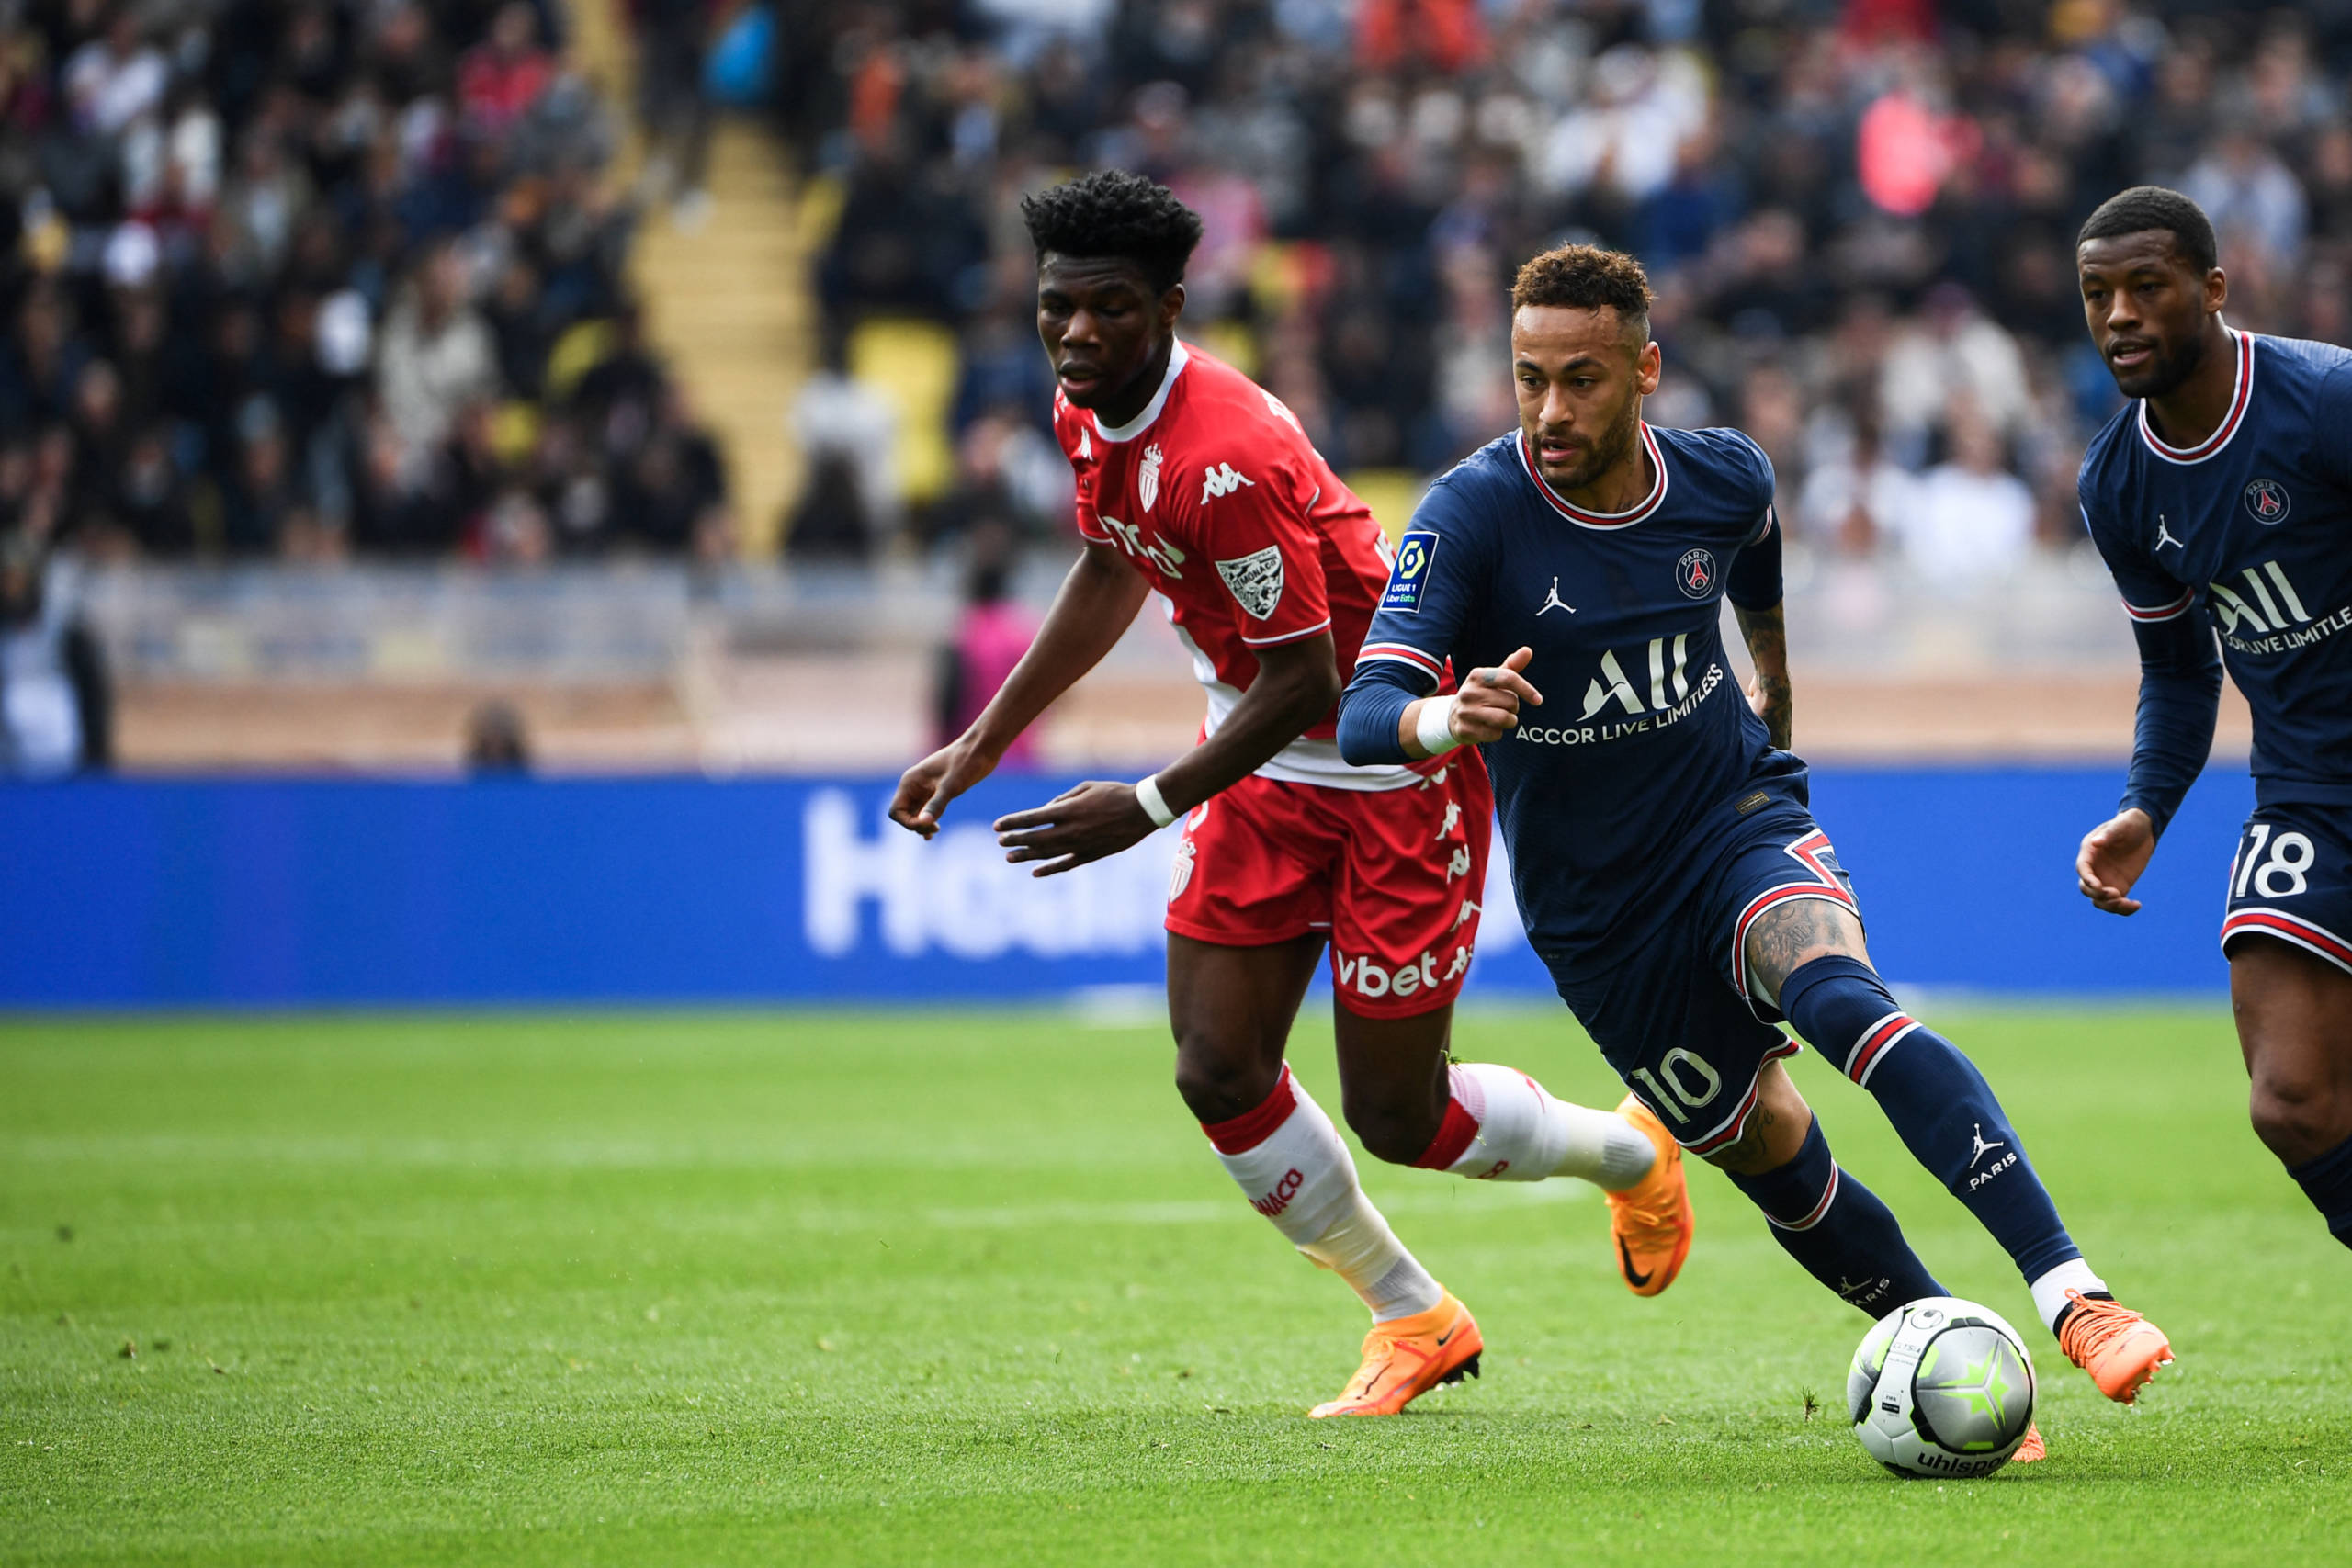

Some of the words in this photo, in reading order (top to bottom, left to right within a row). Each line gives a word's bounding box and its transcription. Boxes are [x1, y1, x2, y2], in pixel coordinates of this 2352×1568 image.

[1240, 559, 1276, 584] MONACO
[1681, 551, 1709, 567] PARIS
[1391, 583, 1411, 592] LIGUE
[1412, 583, 1417, 592] 1
[1516, 724, 1596, 745] ACCOR
[1601, 718, 1651, 741] LIVE
[1655, 662, 1724, 729] LIMITLESS
[2235, 824, 2315, 898] 18
[1337, 950, 1439, 998] vbet
[1631, 1046, 1722, 1124] 10
[1969, 1152, 2017, 1192] PARIS
